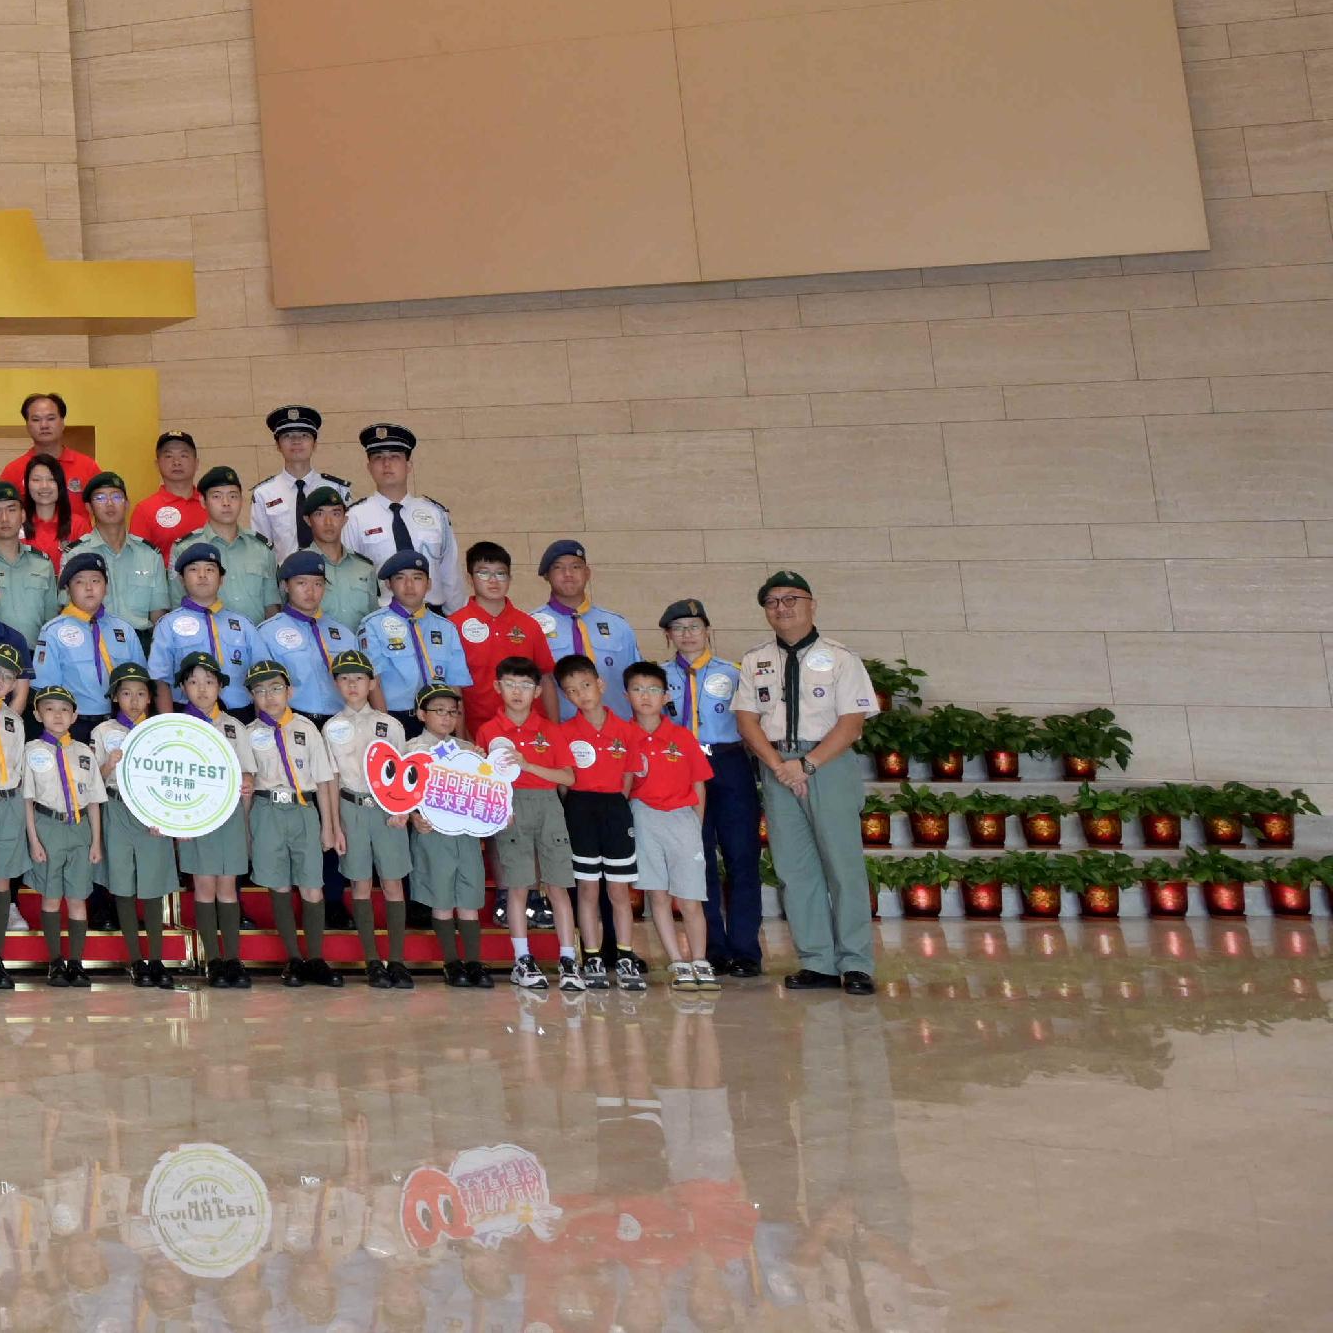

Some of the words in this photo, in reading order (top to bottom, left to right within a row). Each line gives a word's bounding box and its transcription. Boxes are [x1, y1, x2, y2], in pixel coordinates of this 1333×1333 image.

[132, 757, 184, 774] YOUTH
[189, 764, 226, 780] FEST
[429, 767, 507, 802] 正向新世代
